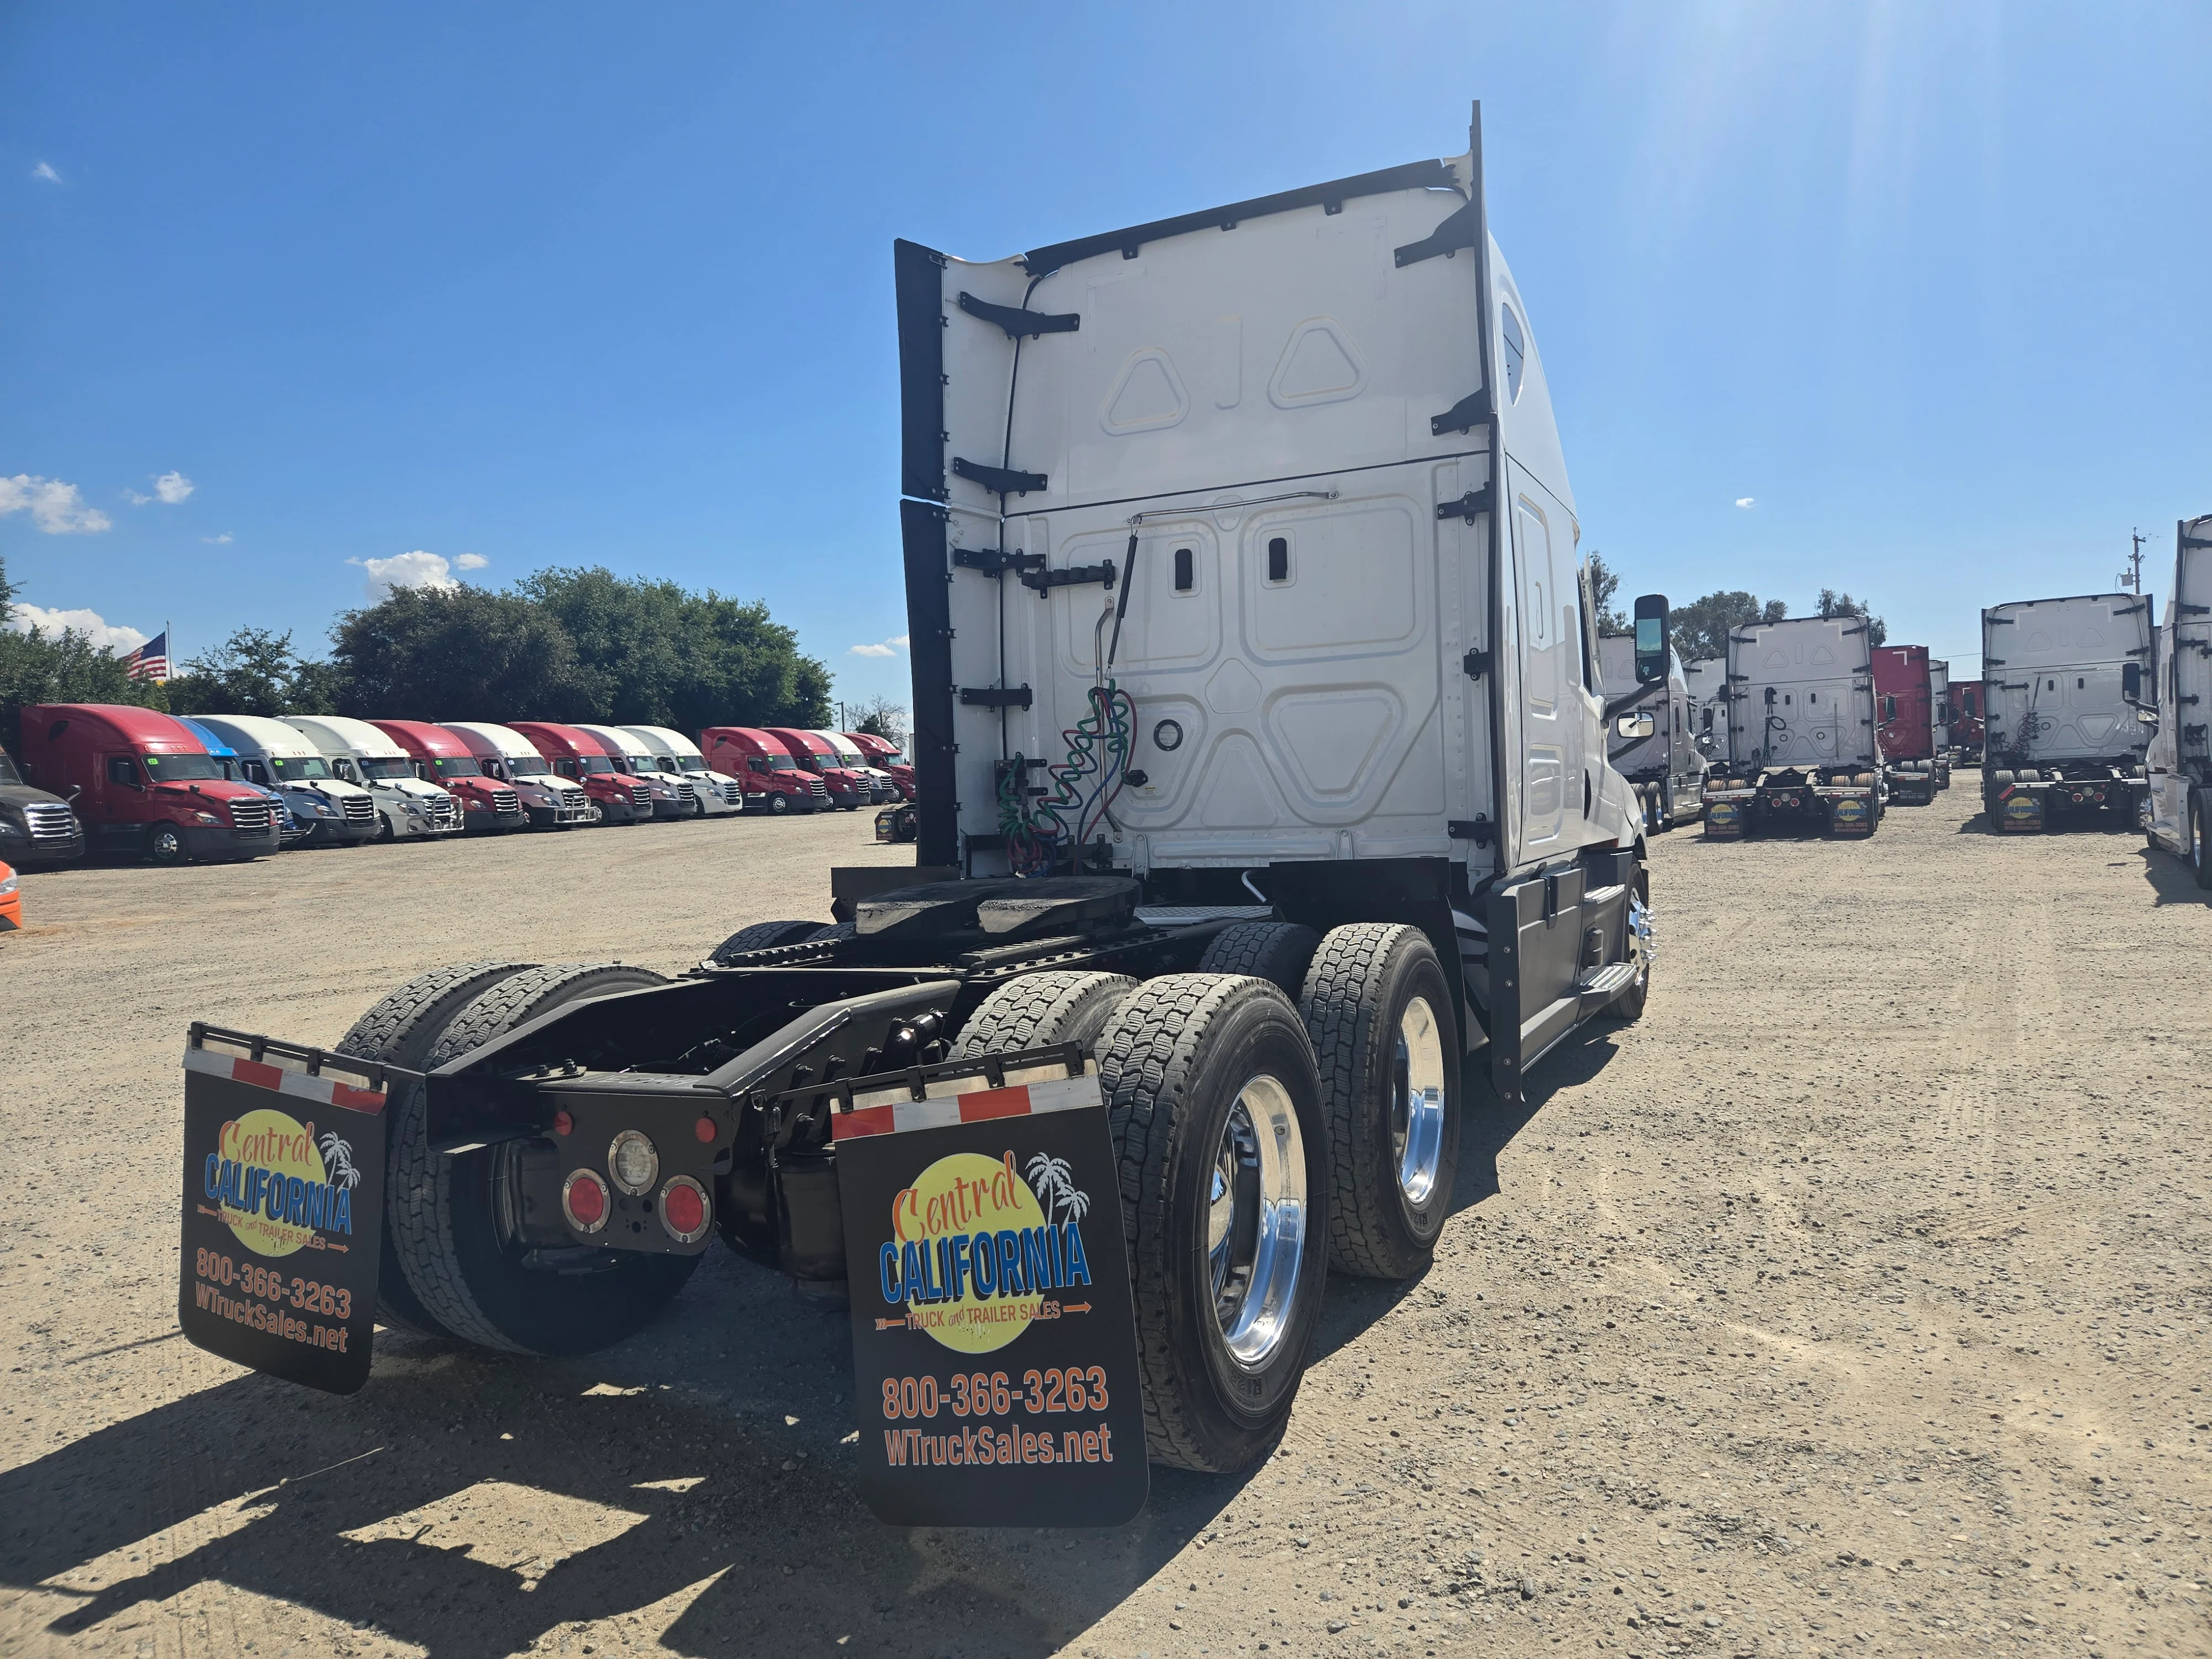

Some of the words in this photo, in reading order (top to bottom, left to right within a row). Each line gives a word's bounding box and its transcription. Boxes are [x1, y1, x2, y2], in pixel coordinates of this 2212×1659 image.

[220, 1120, 316, 1166] Central
[204, 1152, 352, 1235] CALIFORNIA
[893, 1149, 1023, 1245] Central
[217, 1209, 243, 1228] TRUCK
[244, 1218, 258, 1231] and
[258, 1222, 294, 1243] TRAILER
[295, 1232, 326, 1251] SALES
[196, 1247, 351, 1319] 800-366-3263
[880, 1221, 1092, 1305] CALIFORNIA
[195, 1280, 348, 1353] WTruckSales.net
[905, 1311, 945, 1330] TRUCK
[948, 1304, 966, 1327] and
[966, 1305, 1017, 1324] TRAILER
[1019, 1301, 1061, 1320] SALES
[881, 1365, 1109, 1420] 800-366-3263
[884, 1422, 1114, 1467] WTruckSales.net
